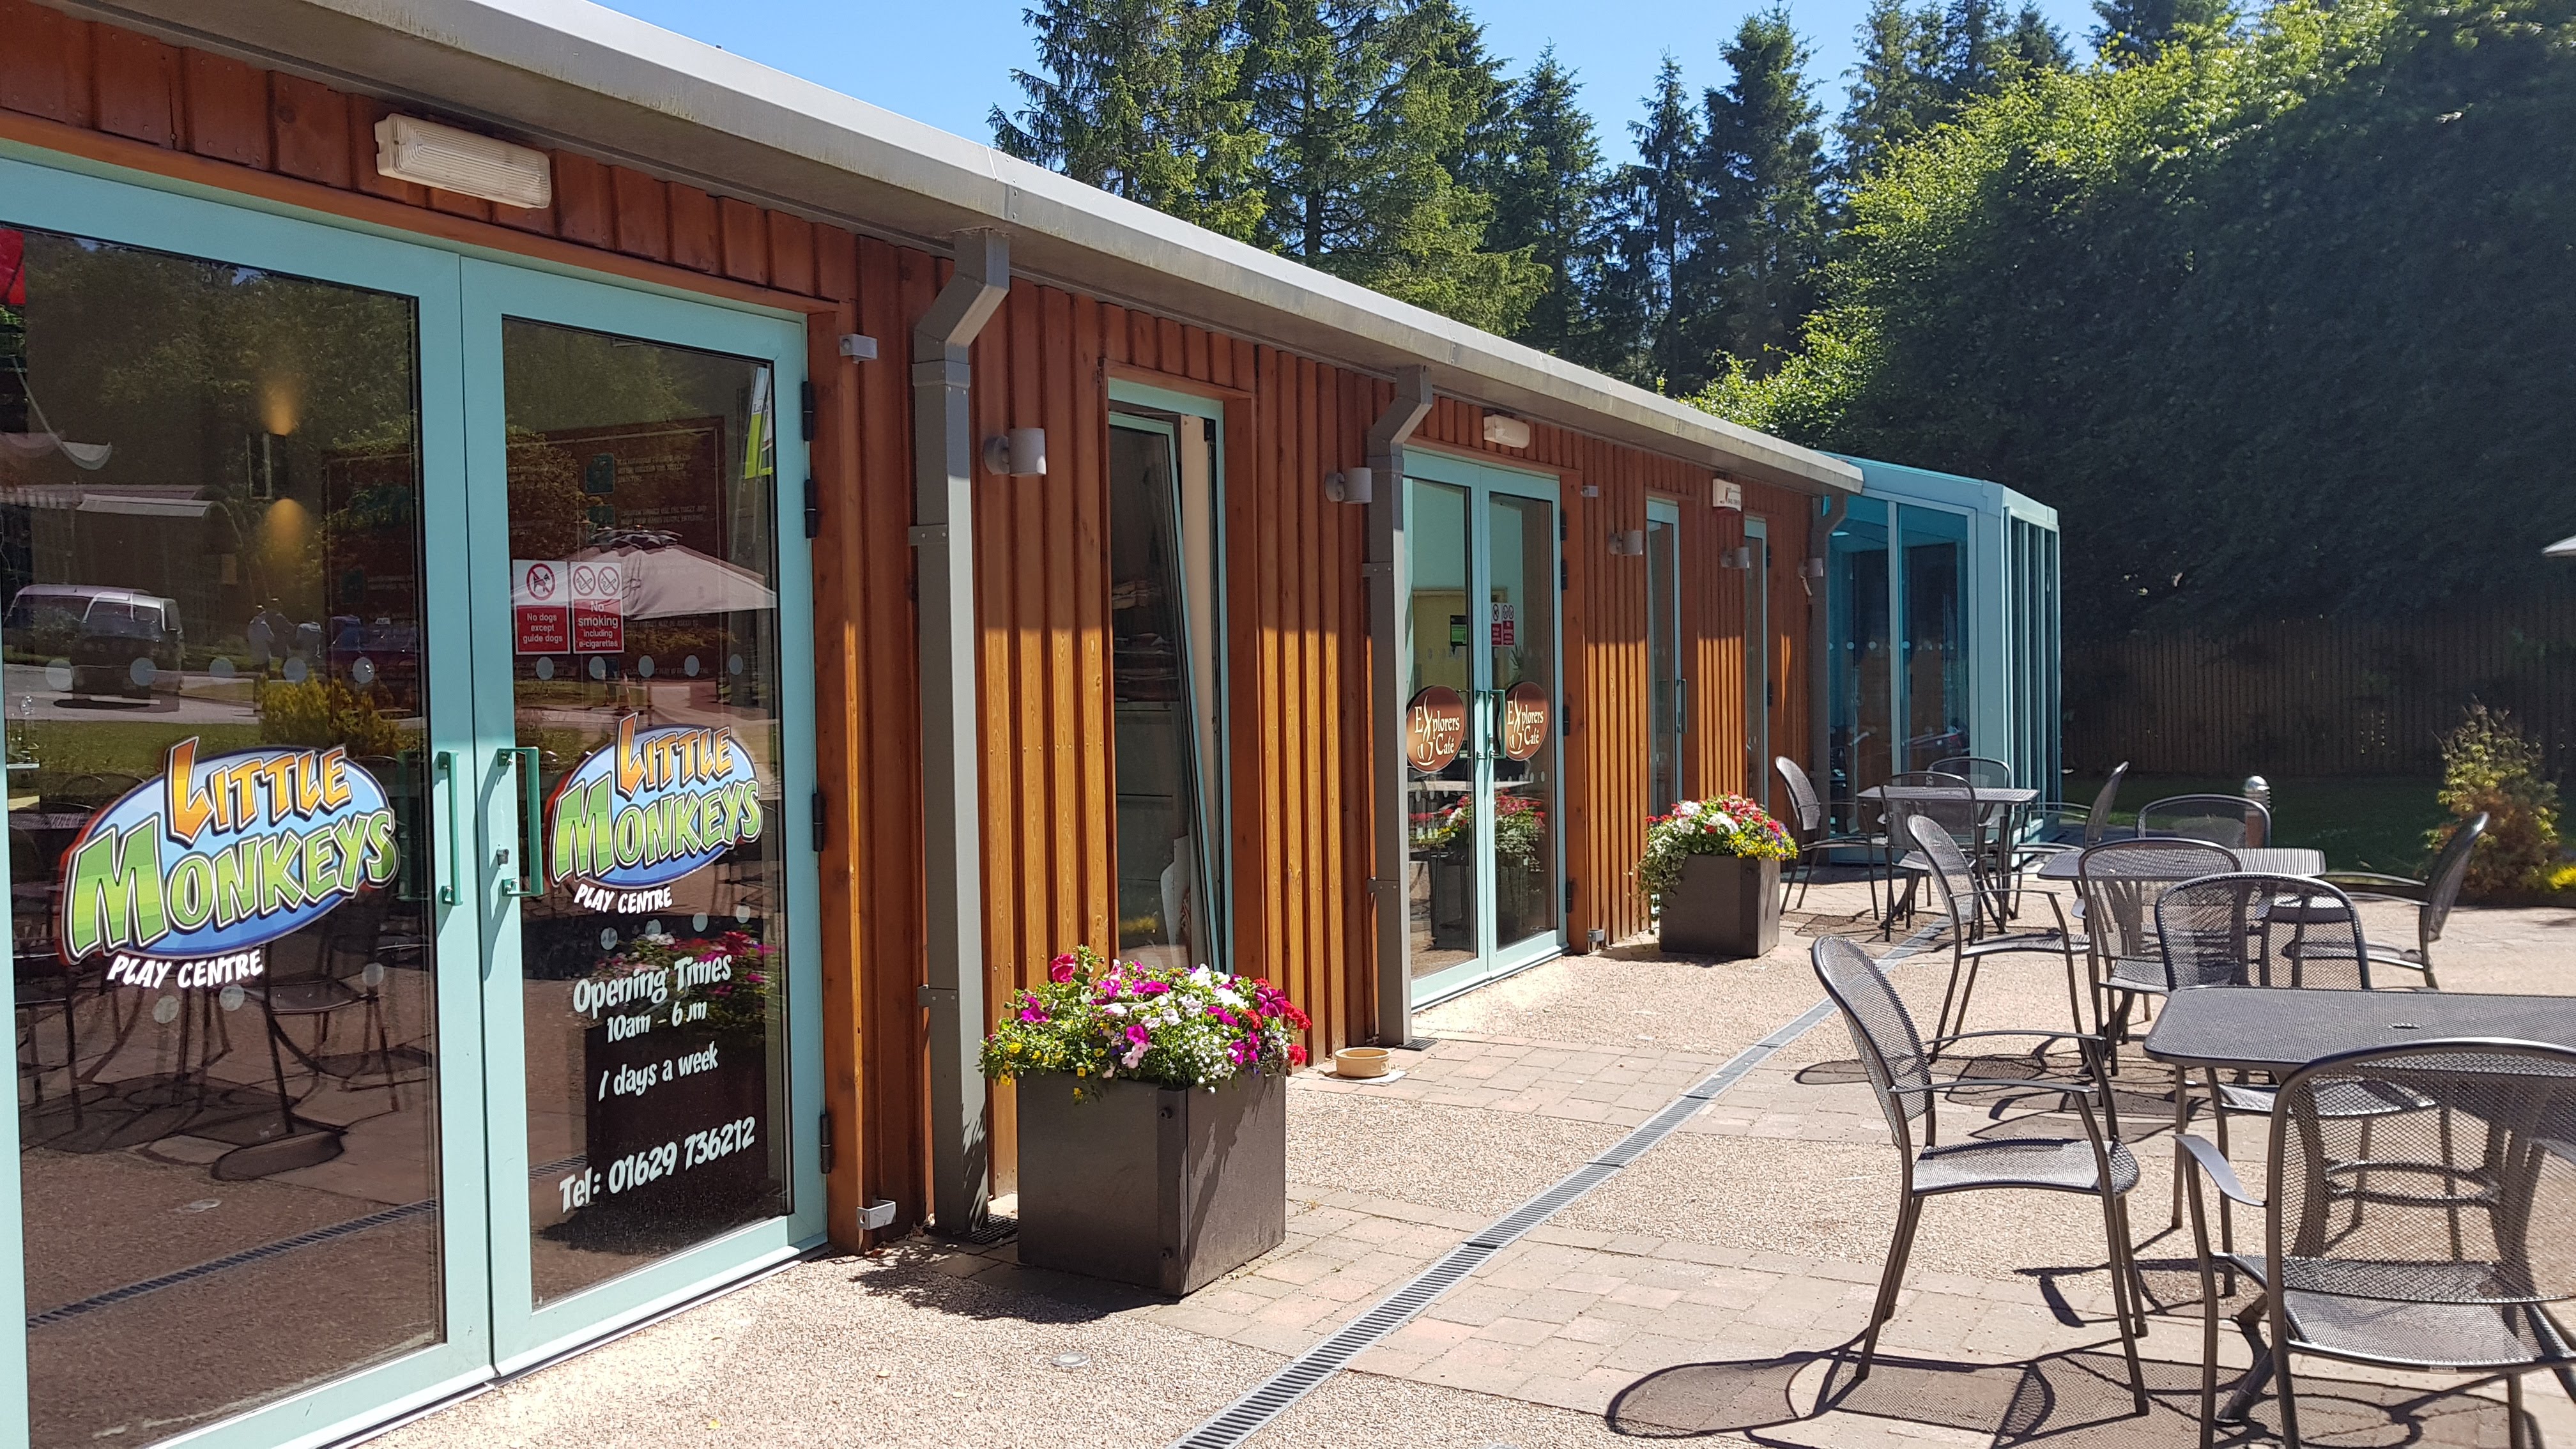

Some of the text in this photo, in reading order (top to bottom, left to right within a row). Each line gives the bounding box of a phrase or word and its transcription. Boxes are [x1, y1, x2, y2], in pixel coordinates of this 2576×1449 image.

[526, 613, 558, 624] No dogs
[590, 601, 604, 612] No
[530, 624, 555, 634] except
[578, 615, 618, 629] smoking
[583, 629, 613, 639] including
[523, 633, 563, 645] guide dogs
[578, 640, 618, 650] e-cigarettes
[1436, 733, 1455, 756] Café
[1524, 724, 1540, 746] Café
[616, 712, 735, 800] LITTLE
[165, 736, 353, 845] LITTLE
[551, 771, 764, 887] MONKEYS
[65, 809, 399, 965] MONKEYS
[574, 883, 673, 914] PLAY CENTRE
[107, 949, 263, 989] PLAY CENTRE
[573, 954, 733, 1020] Opening Times
[607, 1014, 651, 1043] 10am
[613, 1063, 658, 1096] days
[662, 1059, 673, 1082] a
[678, 1040, 719, 1077] week
[559, 1116, 756, 1214] Tel: 01629 736212
